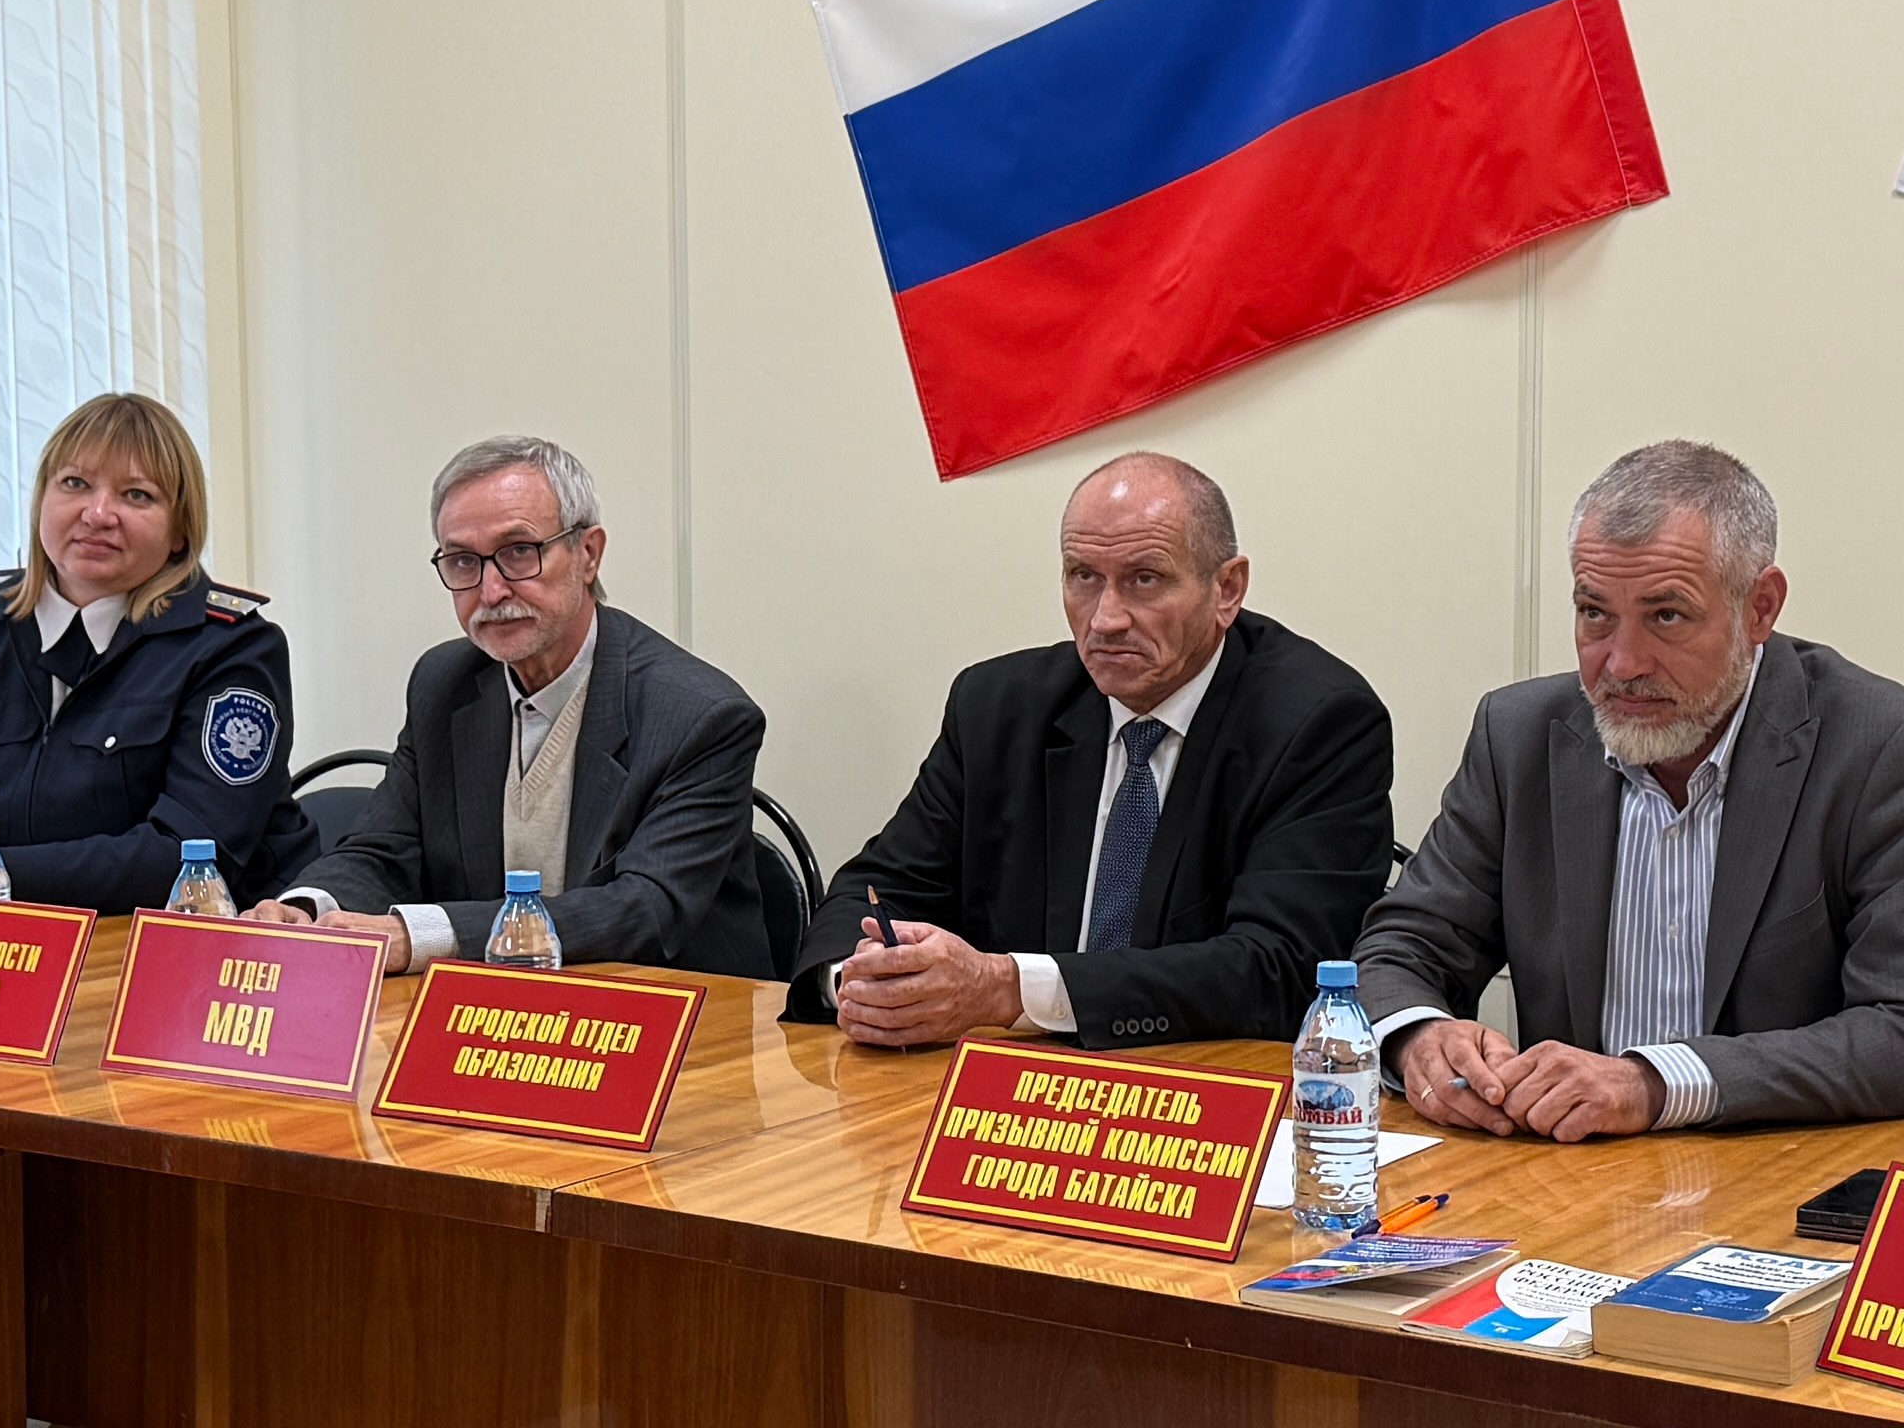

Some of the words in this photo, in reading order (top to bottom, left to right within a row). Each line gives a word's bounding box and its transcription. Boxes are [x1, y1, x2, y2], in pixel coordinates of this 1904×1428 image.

[218, 958, 282, 994] ОТДЕЛ
[202, 1001, 274, 1057] МВД
[445, 1005, 569, 1044] ГОРОДСКОЙ
[569, 1018, 641, 1054] ОТДЕЛ
[452, 1046, 605, 1091] ОБРАЗОВАНИЯ
[1012, 1070, 1201, 1124] ПРЕДСЕДАТЕЛЬ
[942, 1104, 1099, 1156] ПРИЗЫВНОЙ
[1100, 1128, 1249, 1178] КОМИССИИ
[962, 1154, 1058, 1199] ГОРОДА
[1062, 1169, 1196, 1218] БАТАЙСКА
